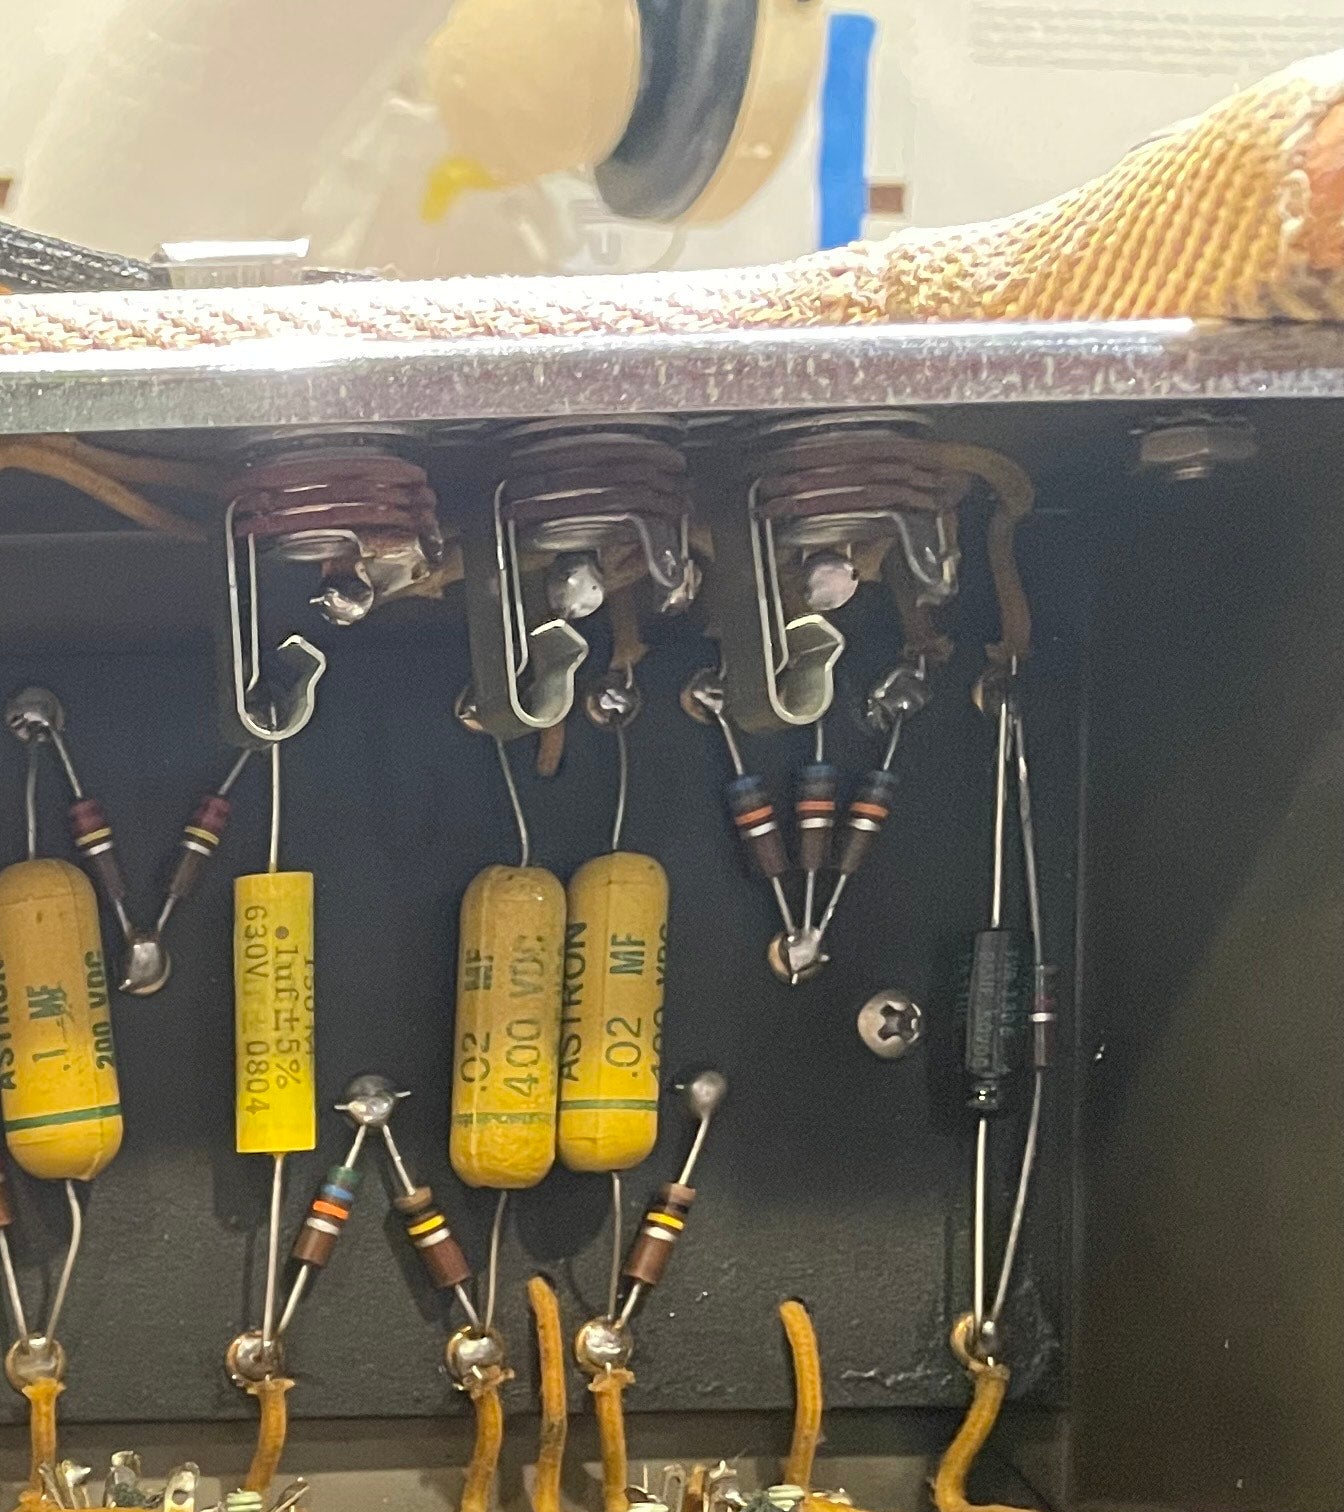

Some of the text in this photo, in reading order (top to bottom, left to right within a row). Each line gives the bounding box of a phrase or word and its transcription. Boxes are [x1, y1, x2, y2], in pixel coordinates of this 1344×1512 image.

[244, 905, 269, 978] 630V
[25, 983, 68, 1020] MF
[605, 932, 645, 1078] .02 MF
[245, 1040, 270, 1115] 0804
[460, 1031, 491, 1093] .02
[503, 1017, 541, 1098] 400
